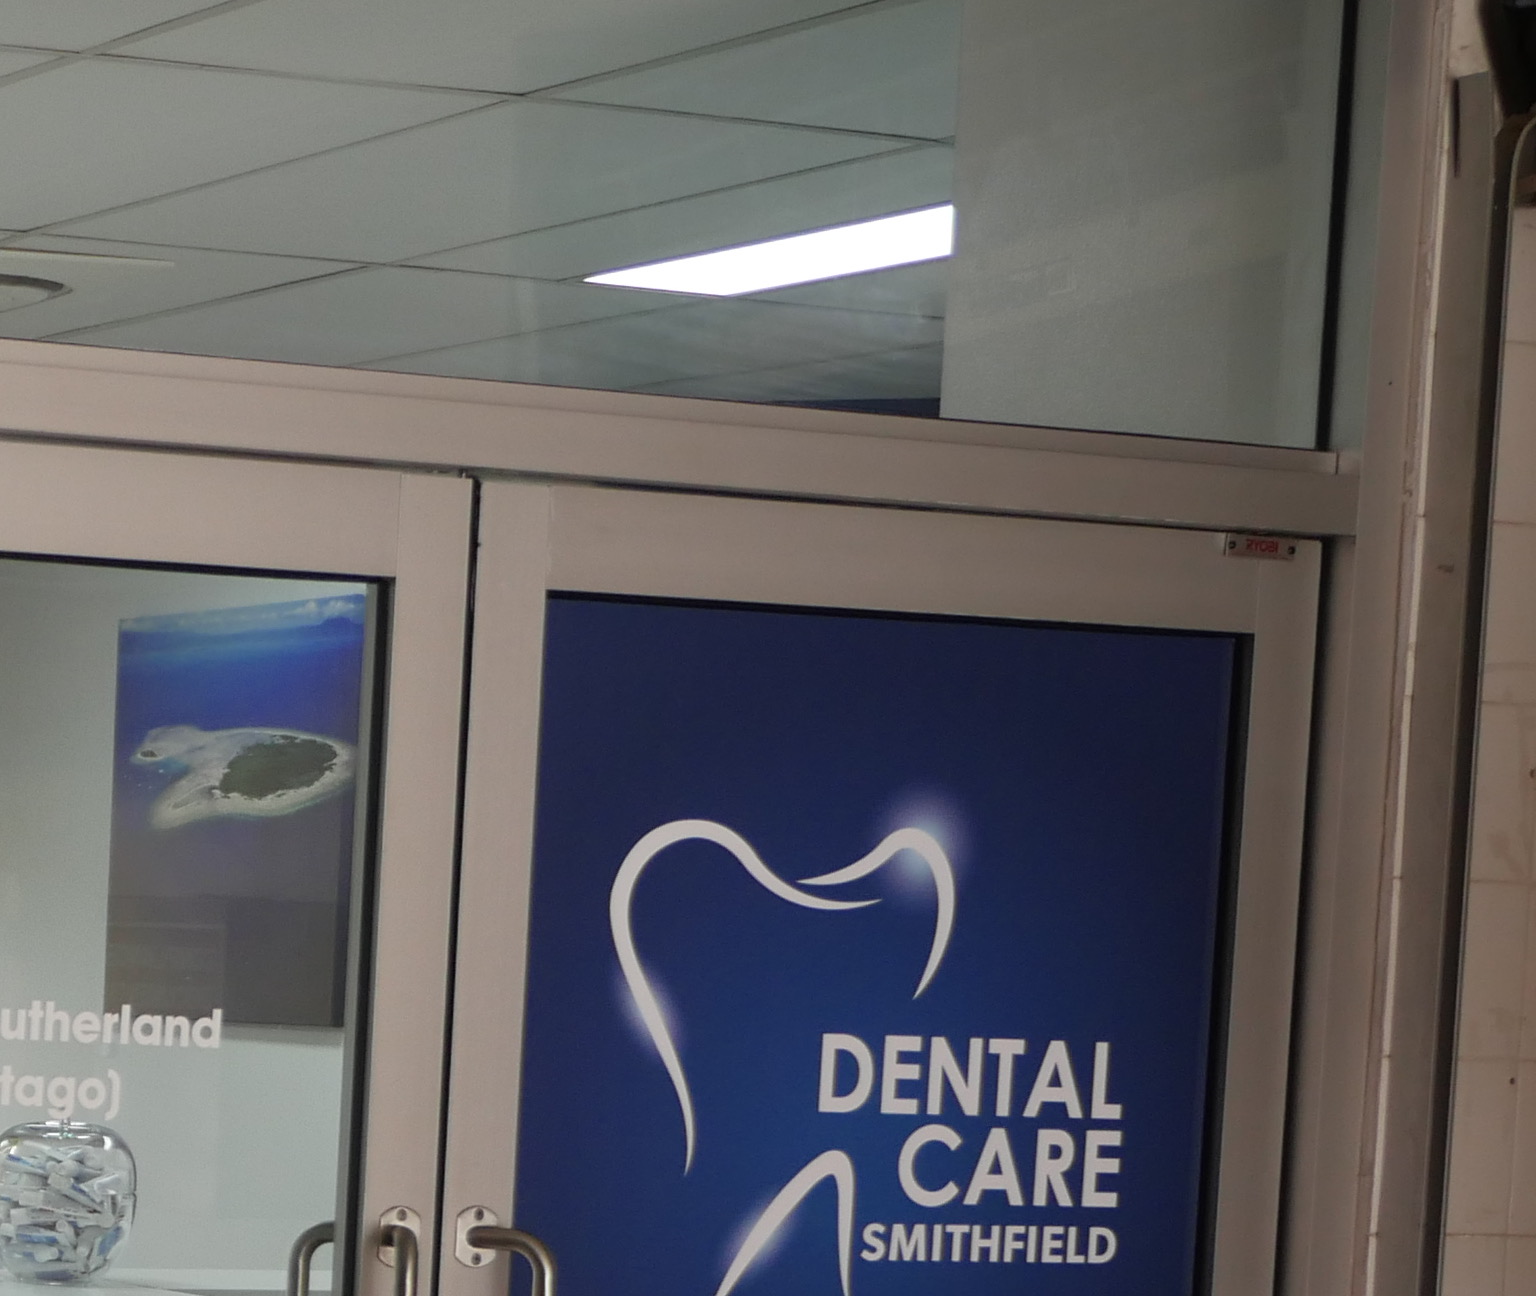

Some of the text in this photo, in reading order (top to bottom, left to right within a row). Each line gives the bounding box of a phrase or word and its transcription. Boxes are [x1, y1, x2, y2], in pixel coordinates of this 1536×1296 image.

[1246, 539, 1280, 553] RYOBI
[818, 1033, 1122, 1120] DENTAL
[897, 1124, 1121, 1208] CARE
[860, 1223, 1118, 1264] SMITHFIELD
